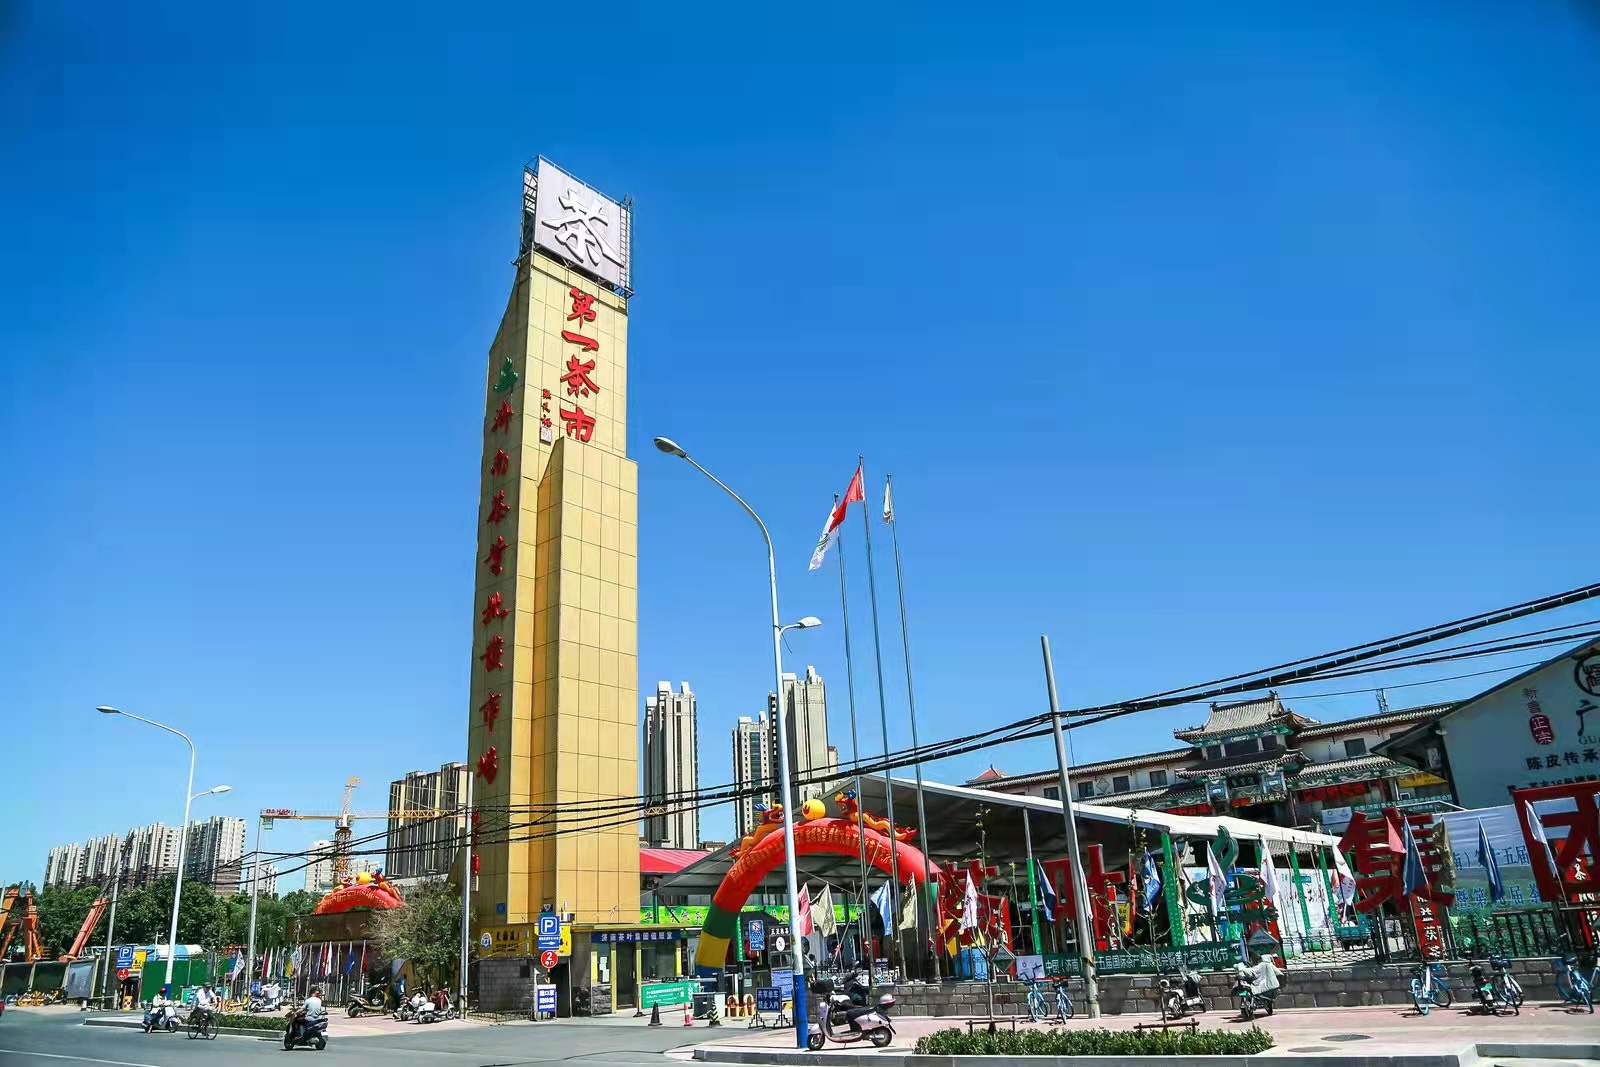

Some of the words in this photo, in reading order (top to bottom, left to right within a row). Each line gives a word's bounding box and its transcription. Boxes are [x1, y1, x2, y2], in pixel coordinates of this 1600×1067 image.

[541, 188, 625, 268] 茶
[560, 286, 600, 443] 第一茶市
[544, 920, 554, 932] P
